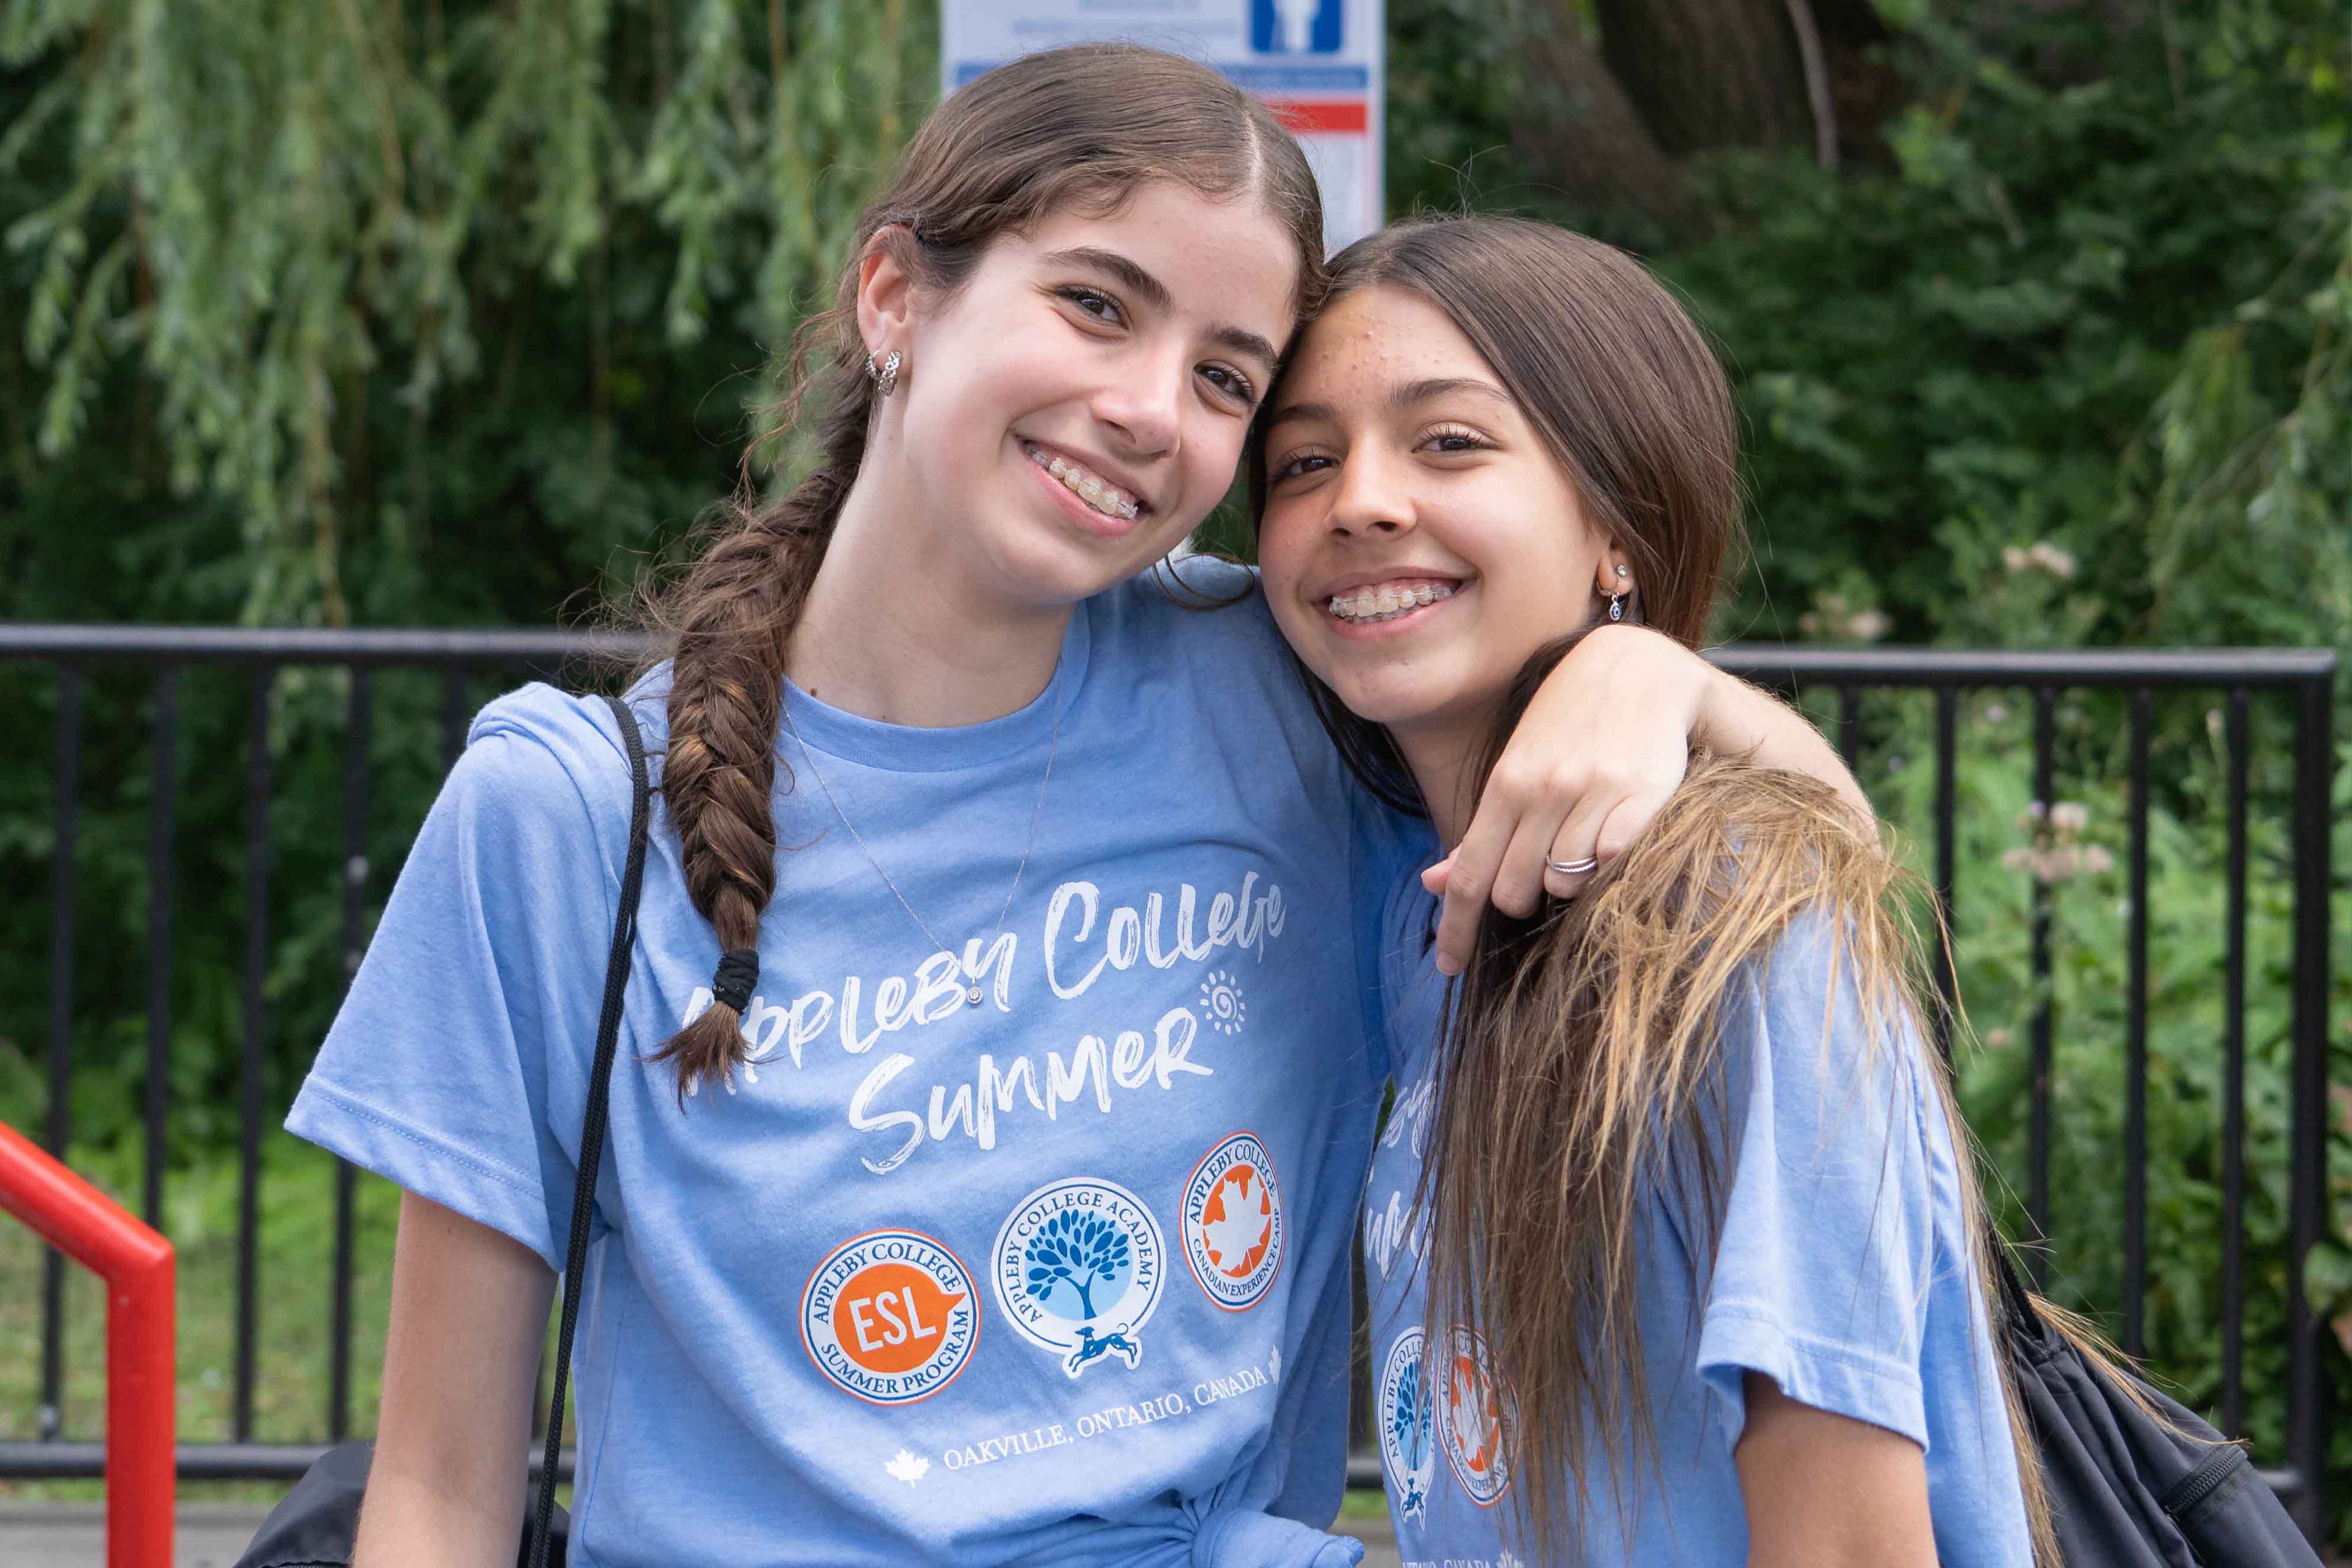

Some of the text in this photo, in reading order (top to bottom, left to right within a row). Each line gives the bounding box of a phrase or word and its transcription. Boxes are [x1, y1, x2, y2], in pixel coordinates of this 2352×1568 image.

[1189, 1144, 1277, 1225] APPLEBY COLLEGE
[813, 1242, 961, 1324] APPLEBY COLLEGE
[1006, 1192, 1152, 1322] APPLEBY COLLEGE ACADEMY
[1194, 1239, 1231, 1296] CANADIAN
[1230, 1248, 1277, 1297] EXPERIENCE
[821, 1309, 969, 1393] SUMMER PROGRAM
[849, 1286, 938, 1353] ESL
[943, 1365, 1268, 1471] OAKVILLE, ONTARIO, CANADA
[1386, 1341, 1423, 1458] APPLEBY COLLE
